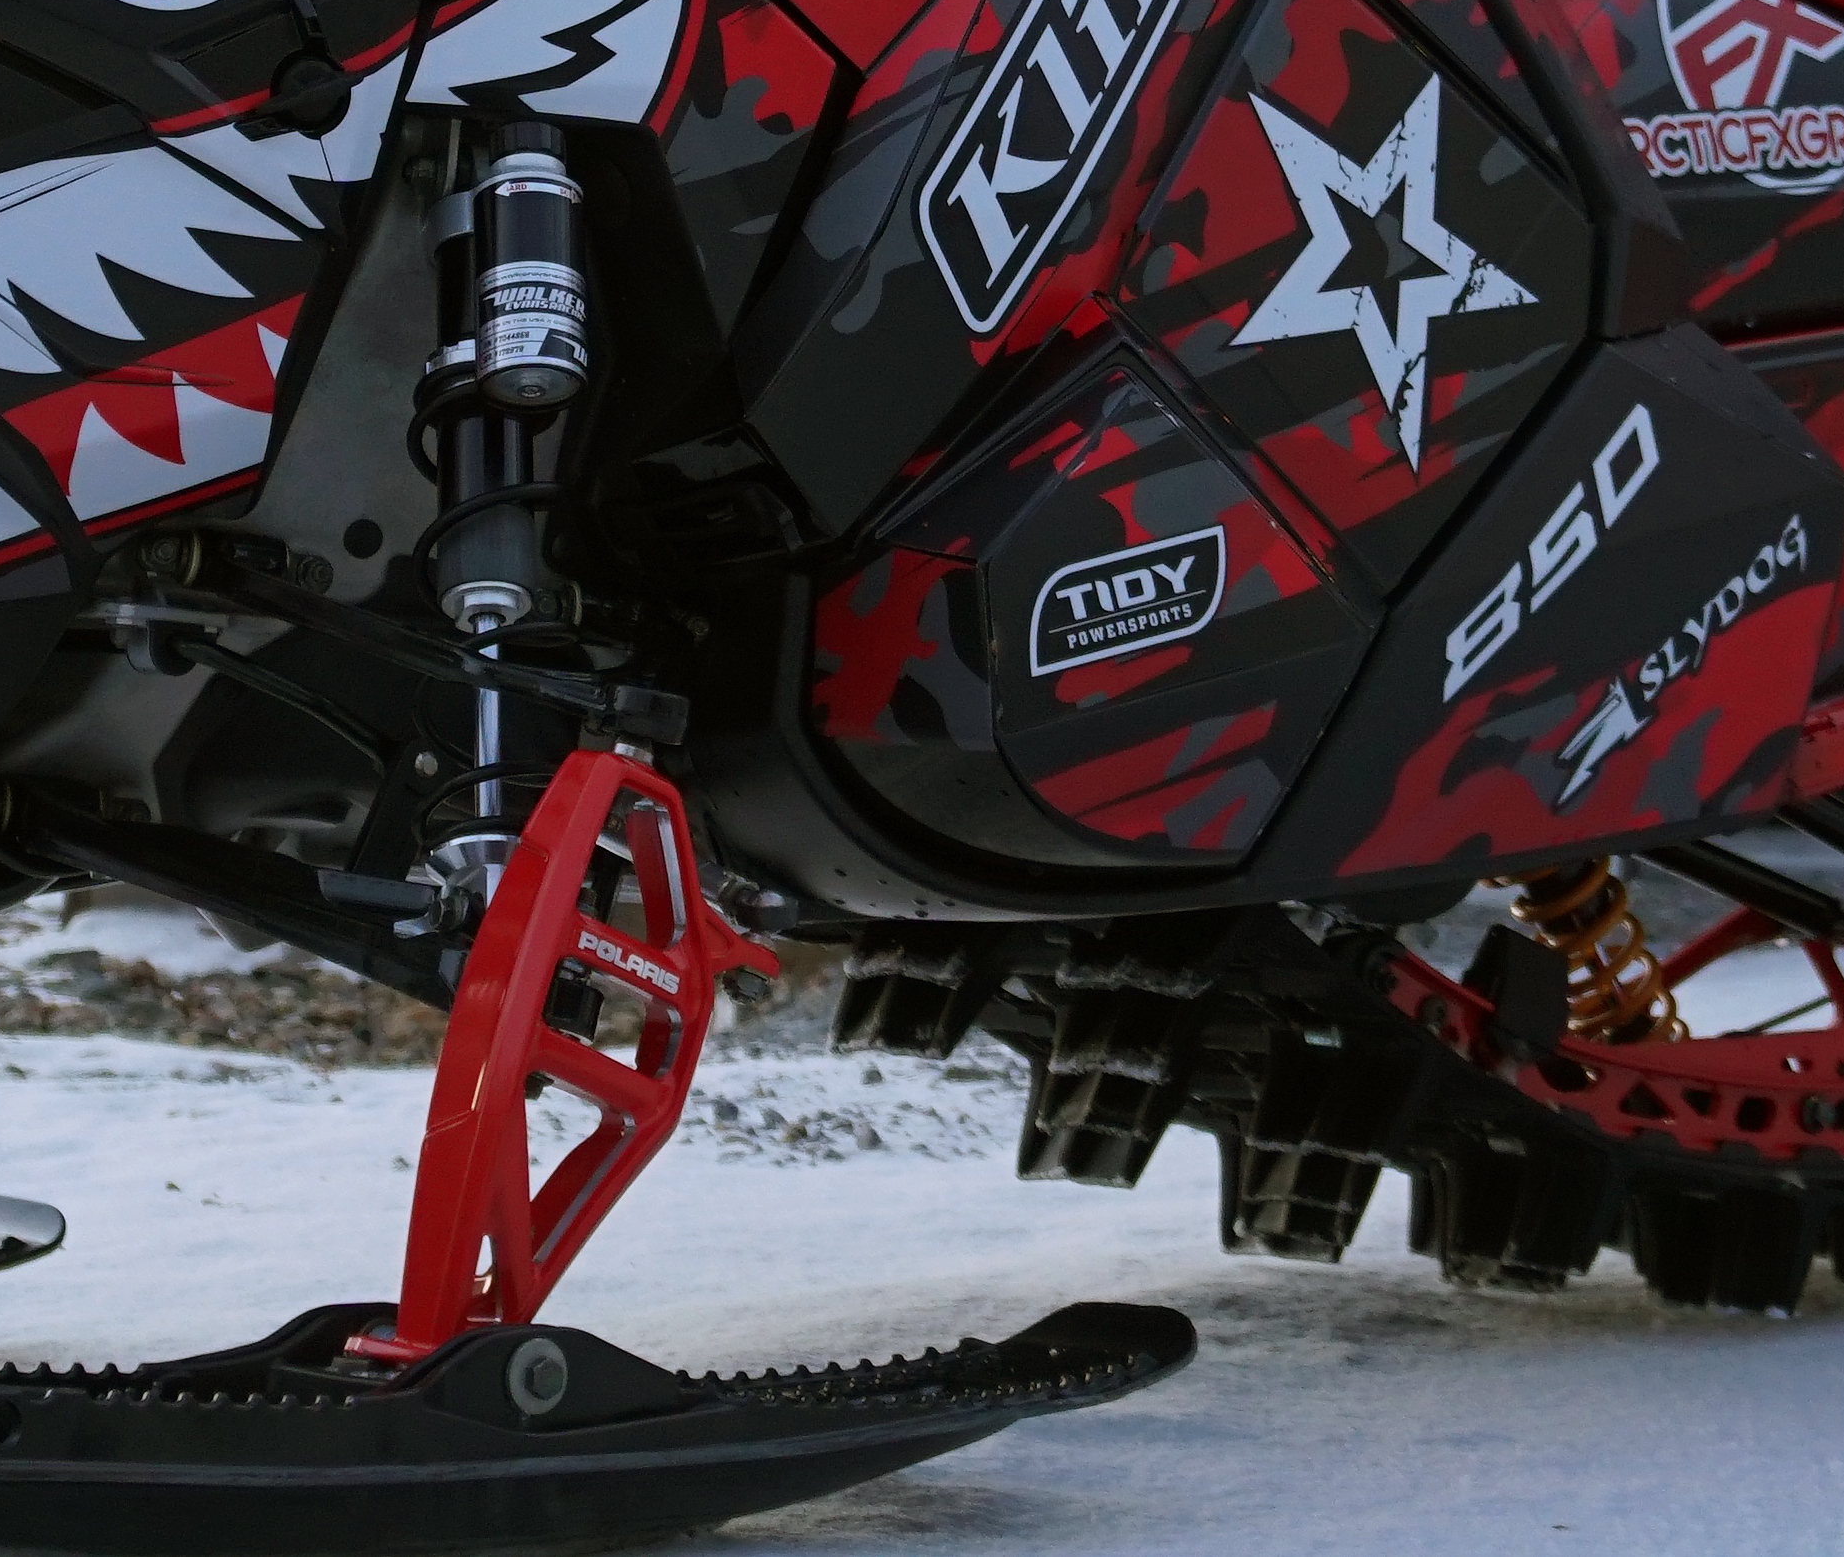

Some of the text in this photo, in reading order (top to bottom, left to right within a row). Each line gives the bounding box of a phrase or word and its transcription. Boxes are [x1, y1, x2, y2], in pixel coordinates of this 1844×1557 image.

[482, 286, 587, 319] WALKER
[1442, 402, 1661, 704] 850
[1055, 554, 1196, 621] TIDY
[1638, 513, 1808, 703] SLYDOG
[1066, 602, 1193, 650] POWERSPORTS
[577, 930, 680, 995] POLARIS
